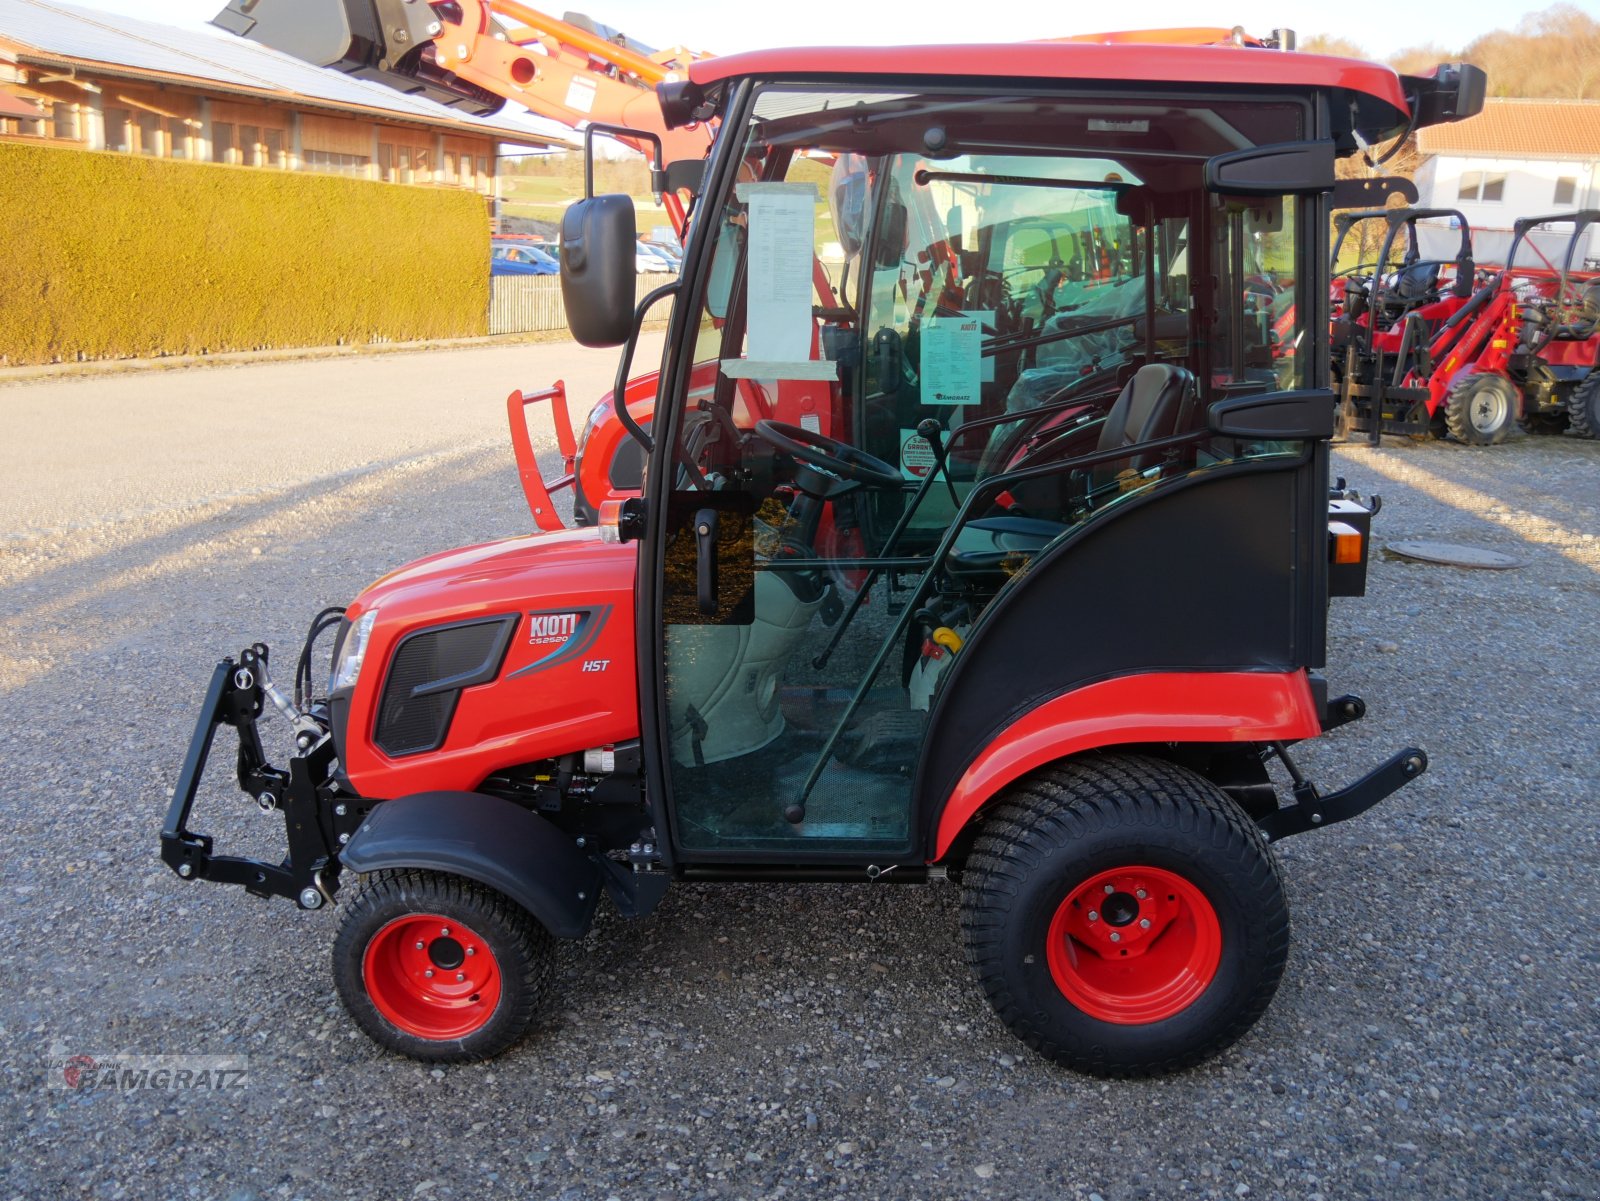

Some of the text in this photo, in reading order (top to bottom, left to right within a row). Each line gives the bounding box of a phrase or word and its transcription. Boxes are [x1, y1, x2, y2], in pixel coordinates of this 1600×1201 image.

[530, 613, 576, 638] KIOTI
[529, 636, 568, 645] CS2520
[582, 660, 610, 672] HST
